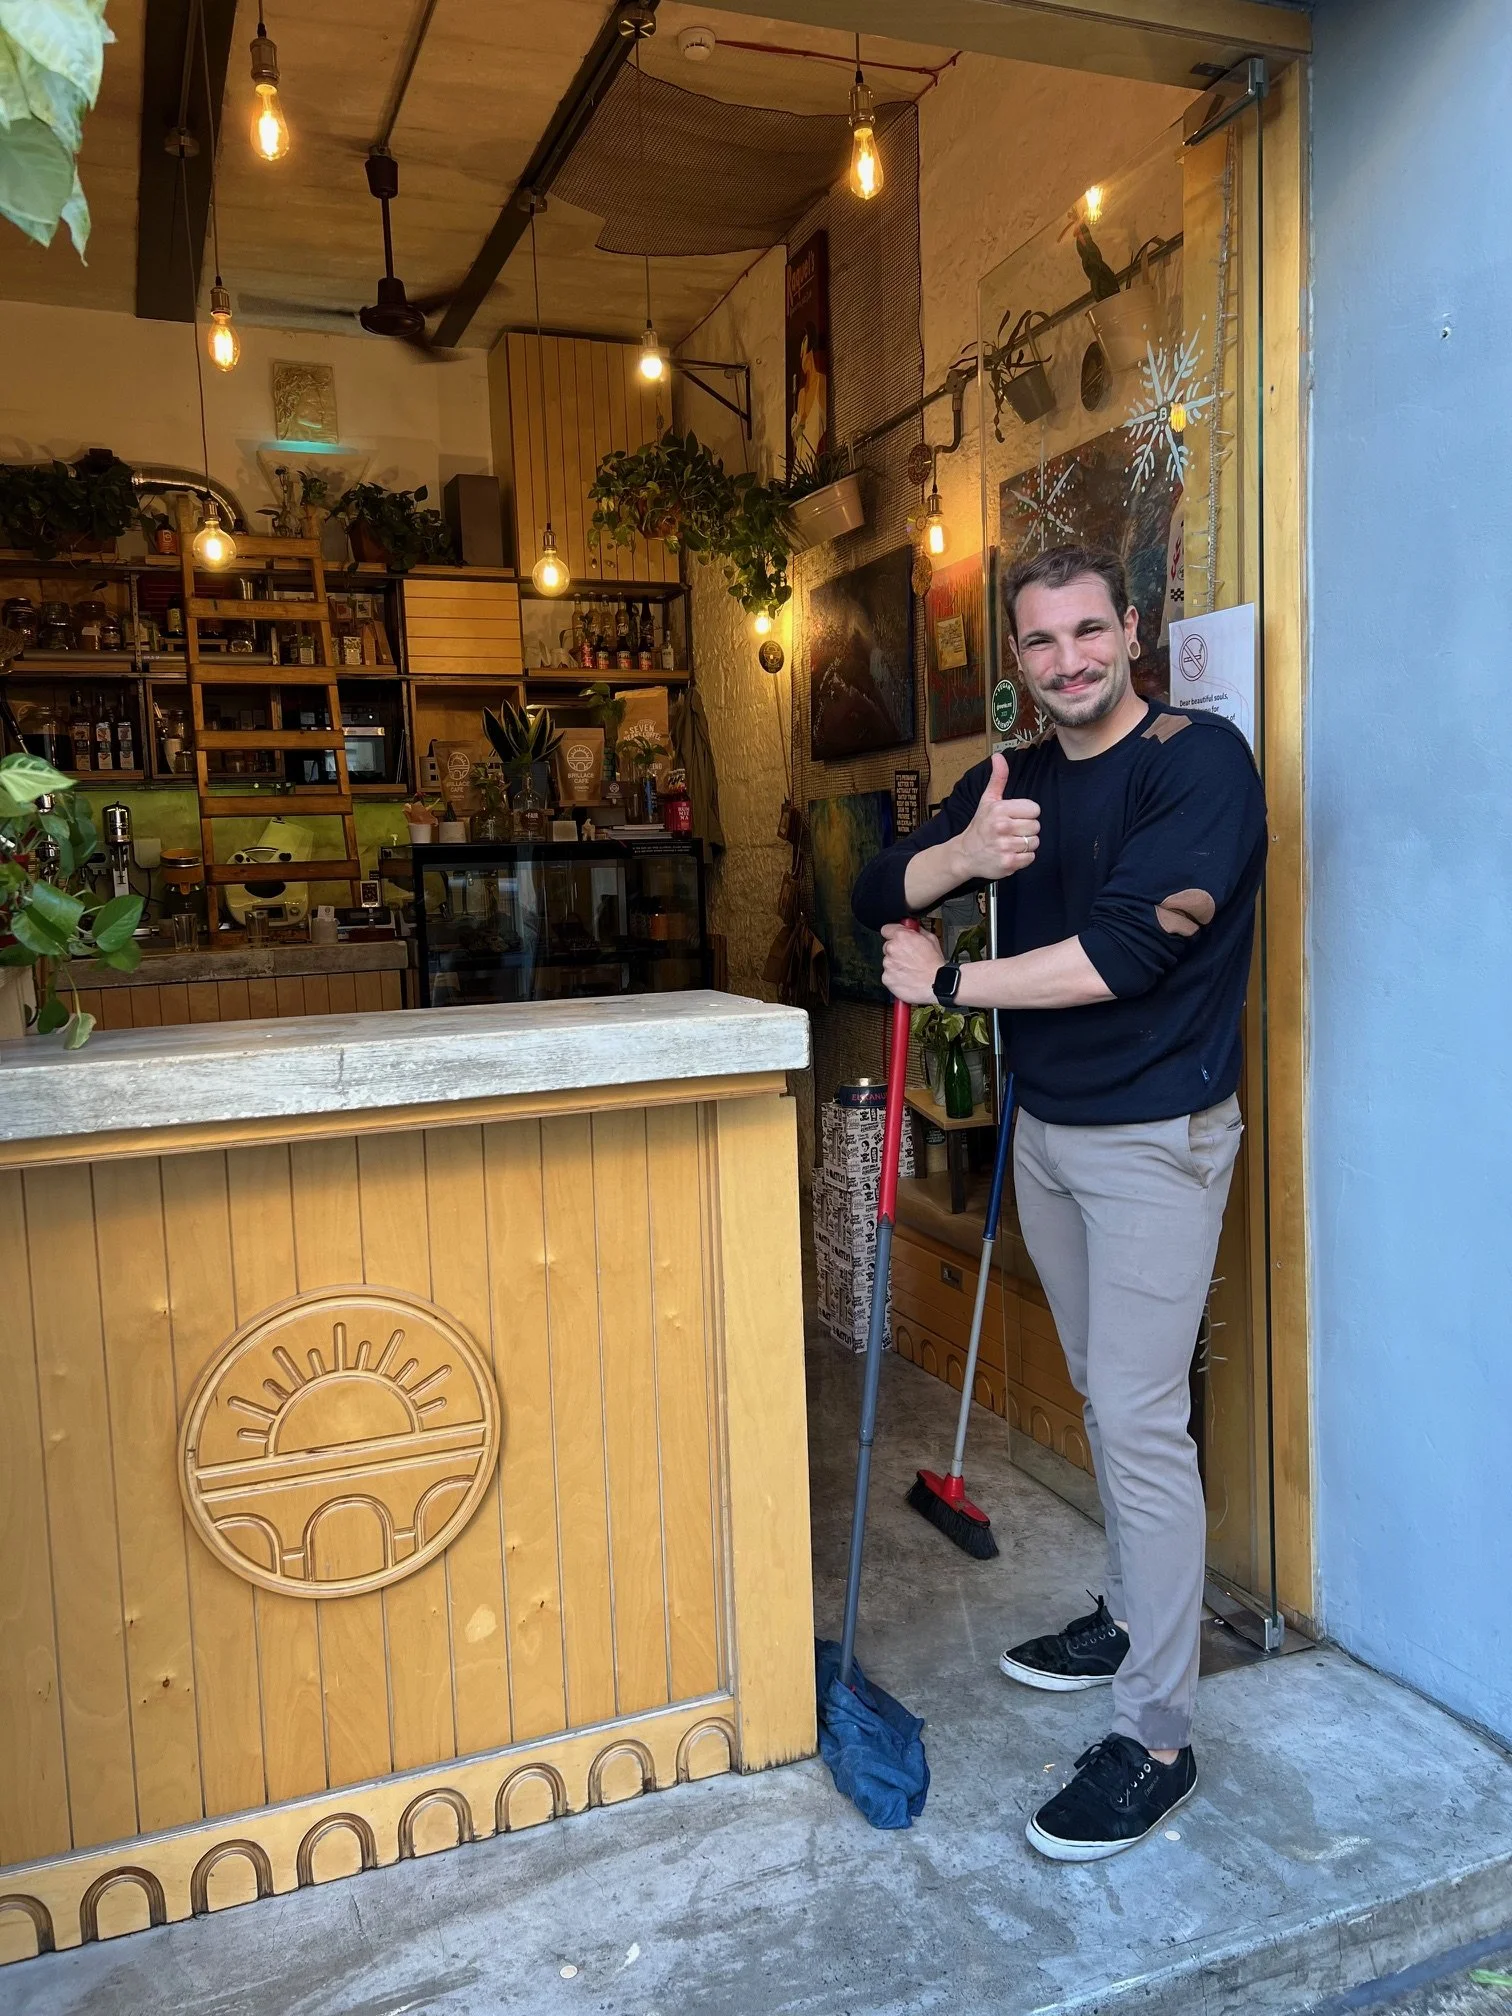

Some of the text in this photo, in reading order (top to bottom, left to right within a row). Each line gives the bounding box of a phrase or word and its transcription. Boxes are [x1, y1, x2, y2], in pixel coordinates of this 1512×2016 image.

[997, 682, 1011, 692] VEGAN
[1179, 692, 1229, 707] Dear beautiful souls,
[995, 714, 1013, 729] FRIENDLY
[629, 723, 655, 734] SEVEN
[642, 731, 662, 741] COFFEE
